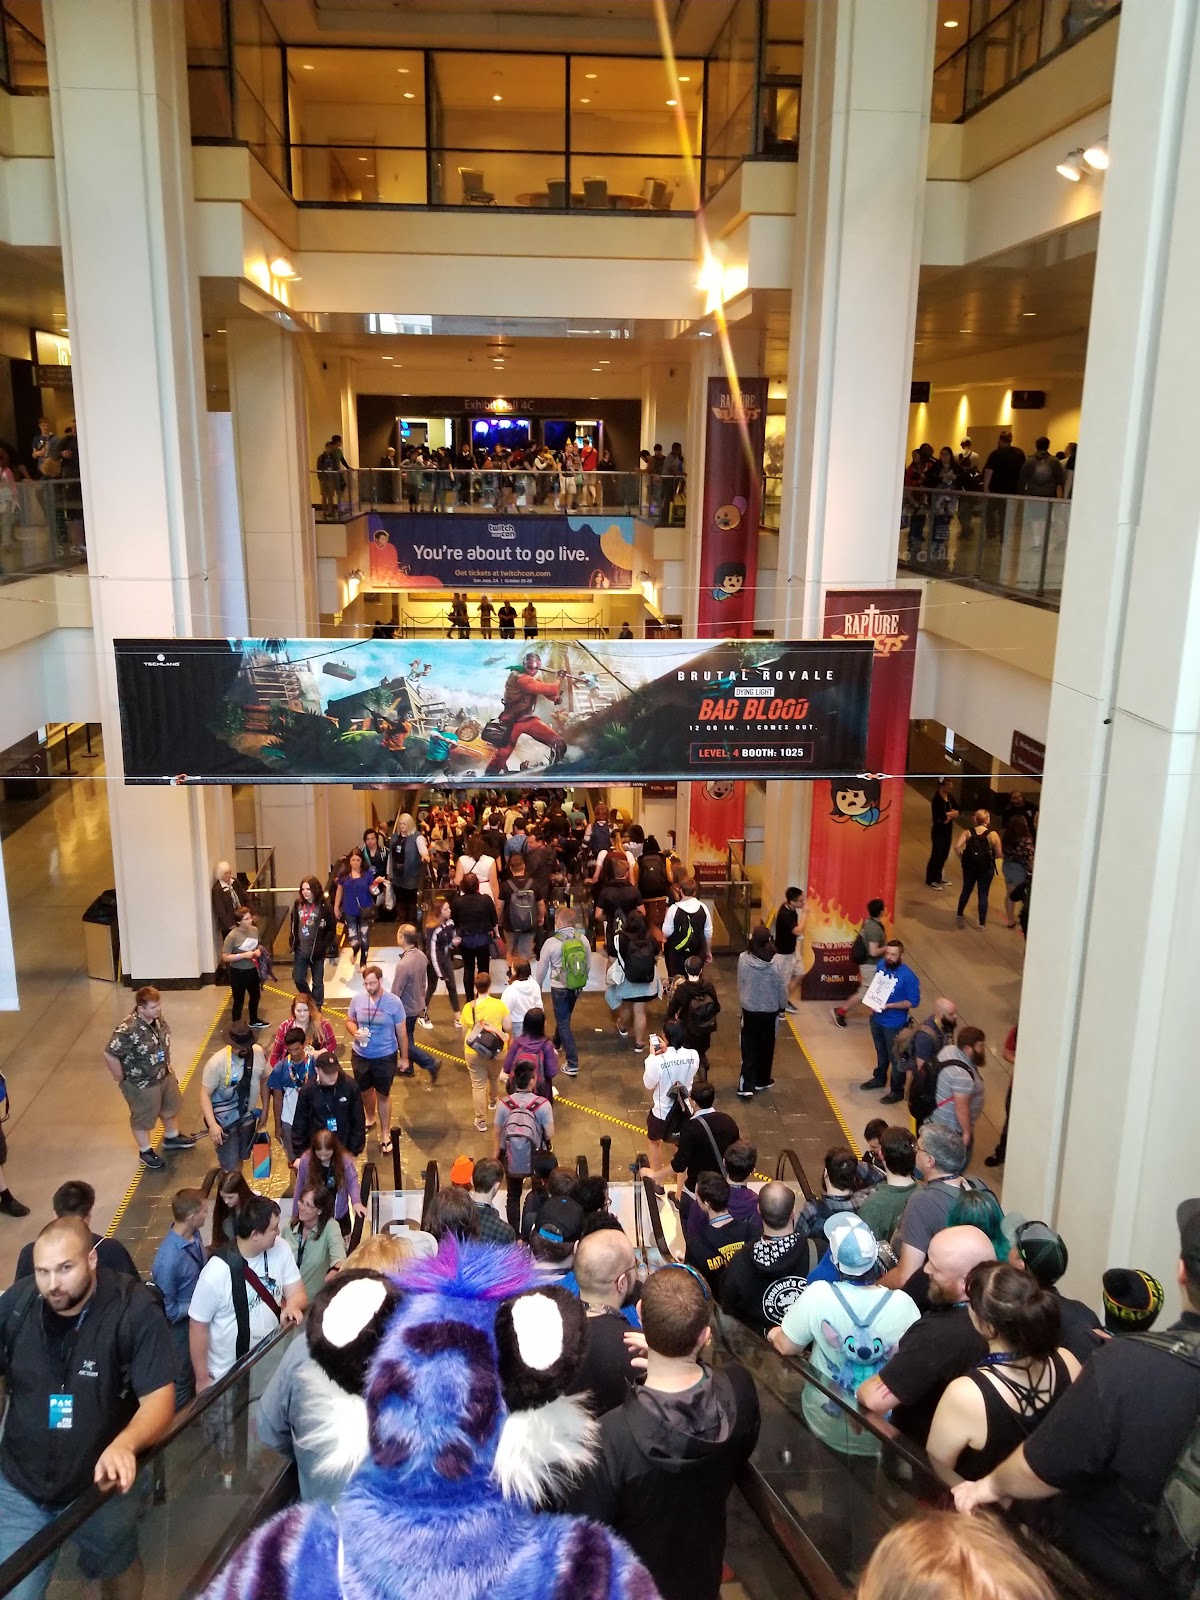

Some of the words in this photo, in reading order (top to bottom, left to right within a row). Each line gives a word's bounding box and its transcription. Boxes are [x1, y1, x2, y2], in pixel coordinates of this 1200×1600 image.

[521, 400, 535, 411] 4C
[489, 524, 514, 532] twitch
[501, 531, 516, 539] con
[413, 545, 462, 561] You’re
[467, 546, 512, 561] about
[516, 546, 531, 561] to
[535, 549, 555, 564] go
[559, 546, 590, 562] live.
[454, 569, 467, 577] Get
[468, 569, 491, 577] tickets
[500, 569, 551, 577] twitchcon.com
[843, 604, 899, 637] RAPTURE
[677, 670, 750, 681] BRUTAL
[762, 670, 834, 681] ROYALE
[698, 699, 740, 720] BAD
[742, 698, 810, 720] BLOOD
[698, 749, 730, 758] LEVEL:
[733, 749, 740, 757] 4
[742, 748, 777, 757] BOOTH:
[780, 748, 804, 757] 1025
